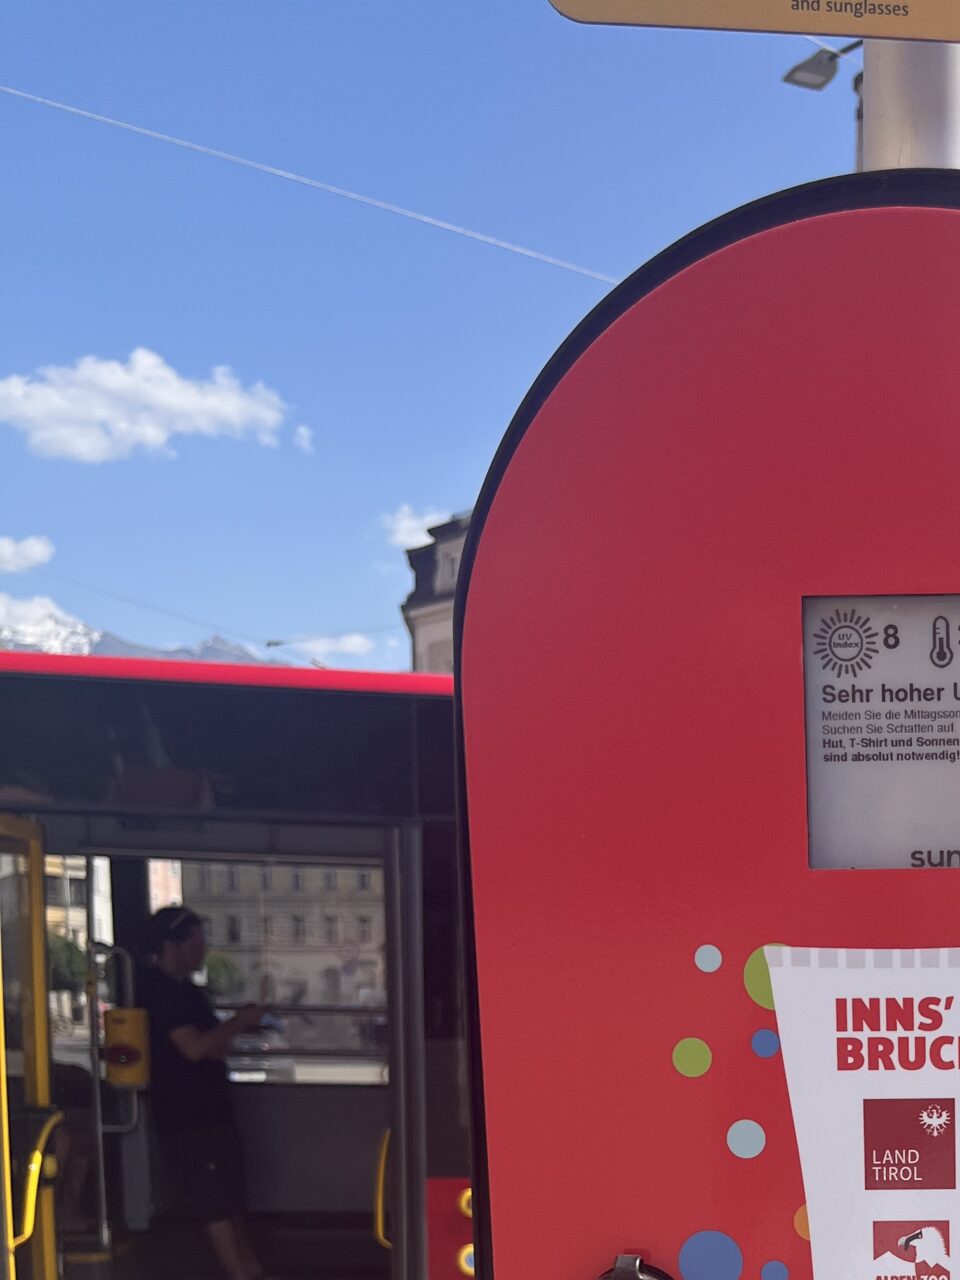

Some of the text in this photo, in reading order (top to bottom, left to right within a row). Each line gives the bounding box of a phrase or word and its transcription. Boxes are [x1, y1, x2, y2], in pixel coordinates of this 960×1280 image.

[791, 0, 909, 17] and sunglasses
[838, 633, 852, 641] UV
[883, 624, 900, 649] 8
[833, 641, 860, 649] Index
[822, 684, 873, 703] Sehr
[881, 683, 945, 702] hoher
[822, 710, 861, 721] Meiden
[864, 710, 881, 720] Sie
[885, 709, 901, 720] die
[822, 724, 863, 735] Suchen
[866, 724, 883, 734] Sie
[886, 723, 933, 734] Schatten
[822, 738, 846, 750] Hut,
[850, 738, 888, 748] T-Shirt
[890, 738, 913, 747] und
[823, 750, 960, 763] sind absolut notwendig!
[871, 1149, 921, 1165] LAND
[871, 1166, 923, 1181] TIROL
